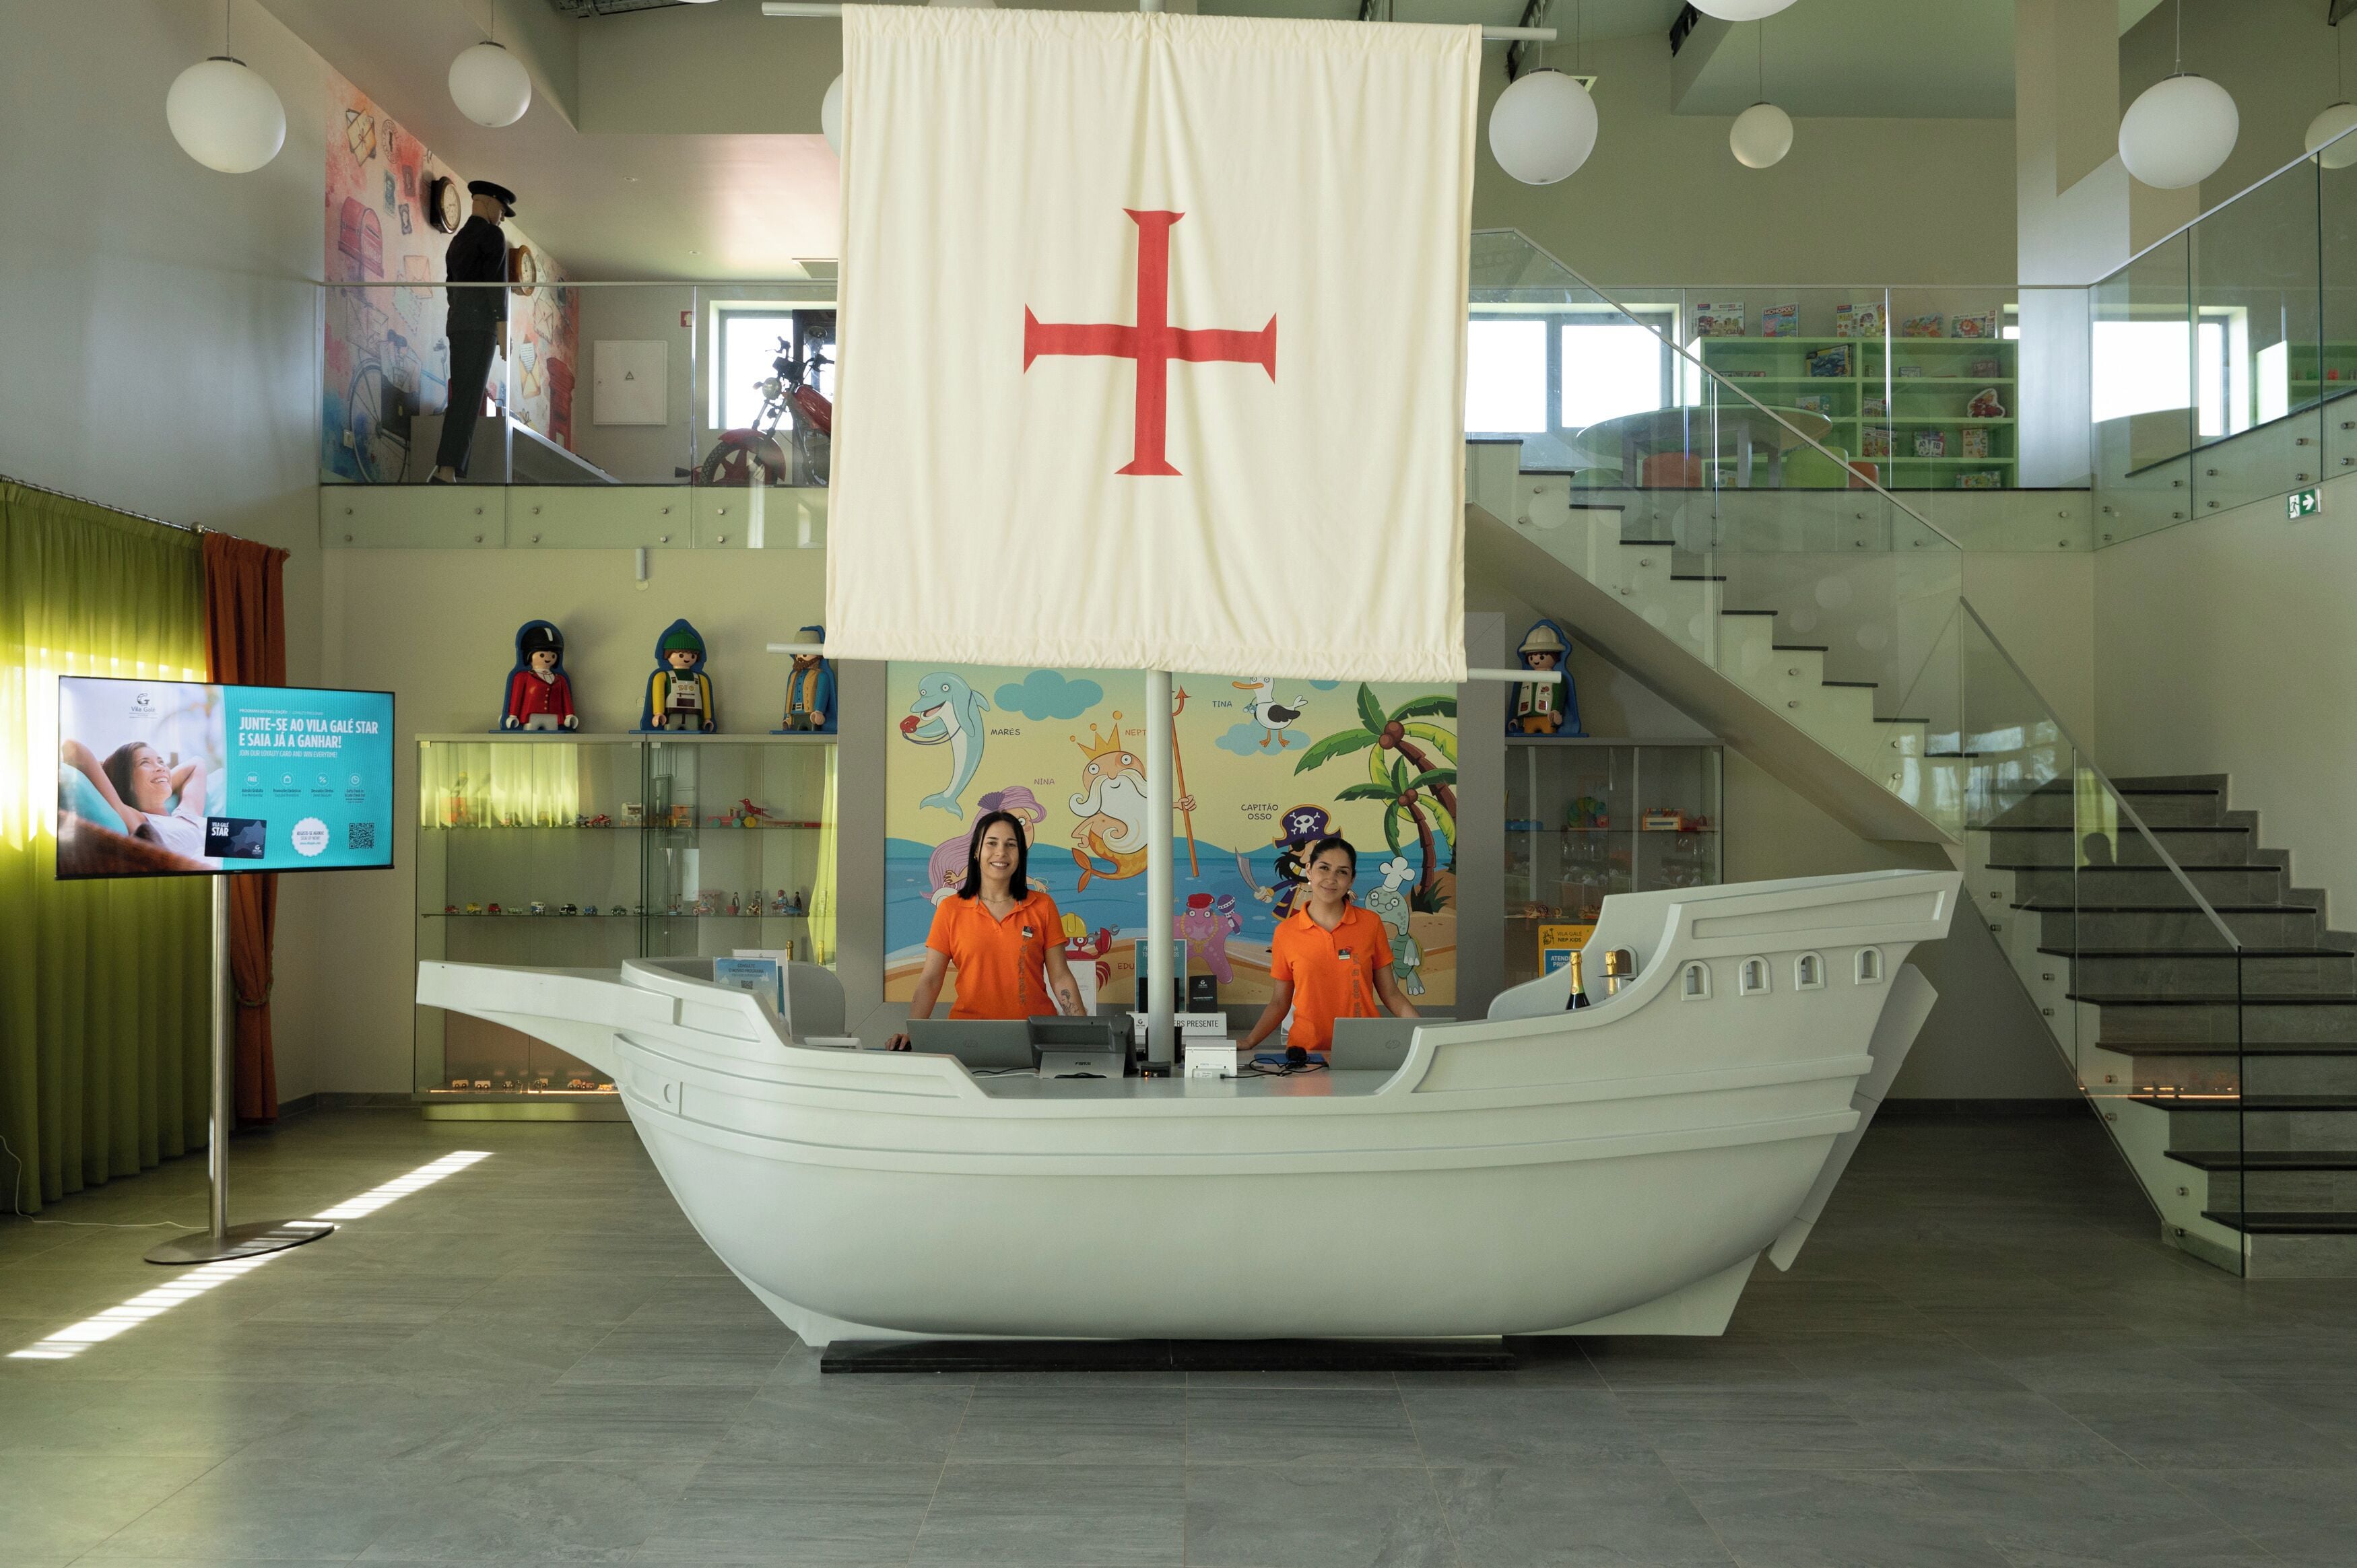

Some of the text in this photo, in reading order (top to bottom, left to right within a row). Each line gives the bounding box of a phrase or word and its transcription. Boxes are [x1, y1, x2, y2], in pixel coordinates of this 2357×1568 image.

[1764, 306, 1795, 315] MONOPOLY
[239, 717, 378, 734] JUNTE-SE AO VILA GALÉ STAR
[991, 728, 1020, 736] MARÉS
[239, 732, 341, 748] E SAIA JÁ A GANHAR!
[211, 827, 229, 836] STAR
